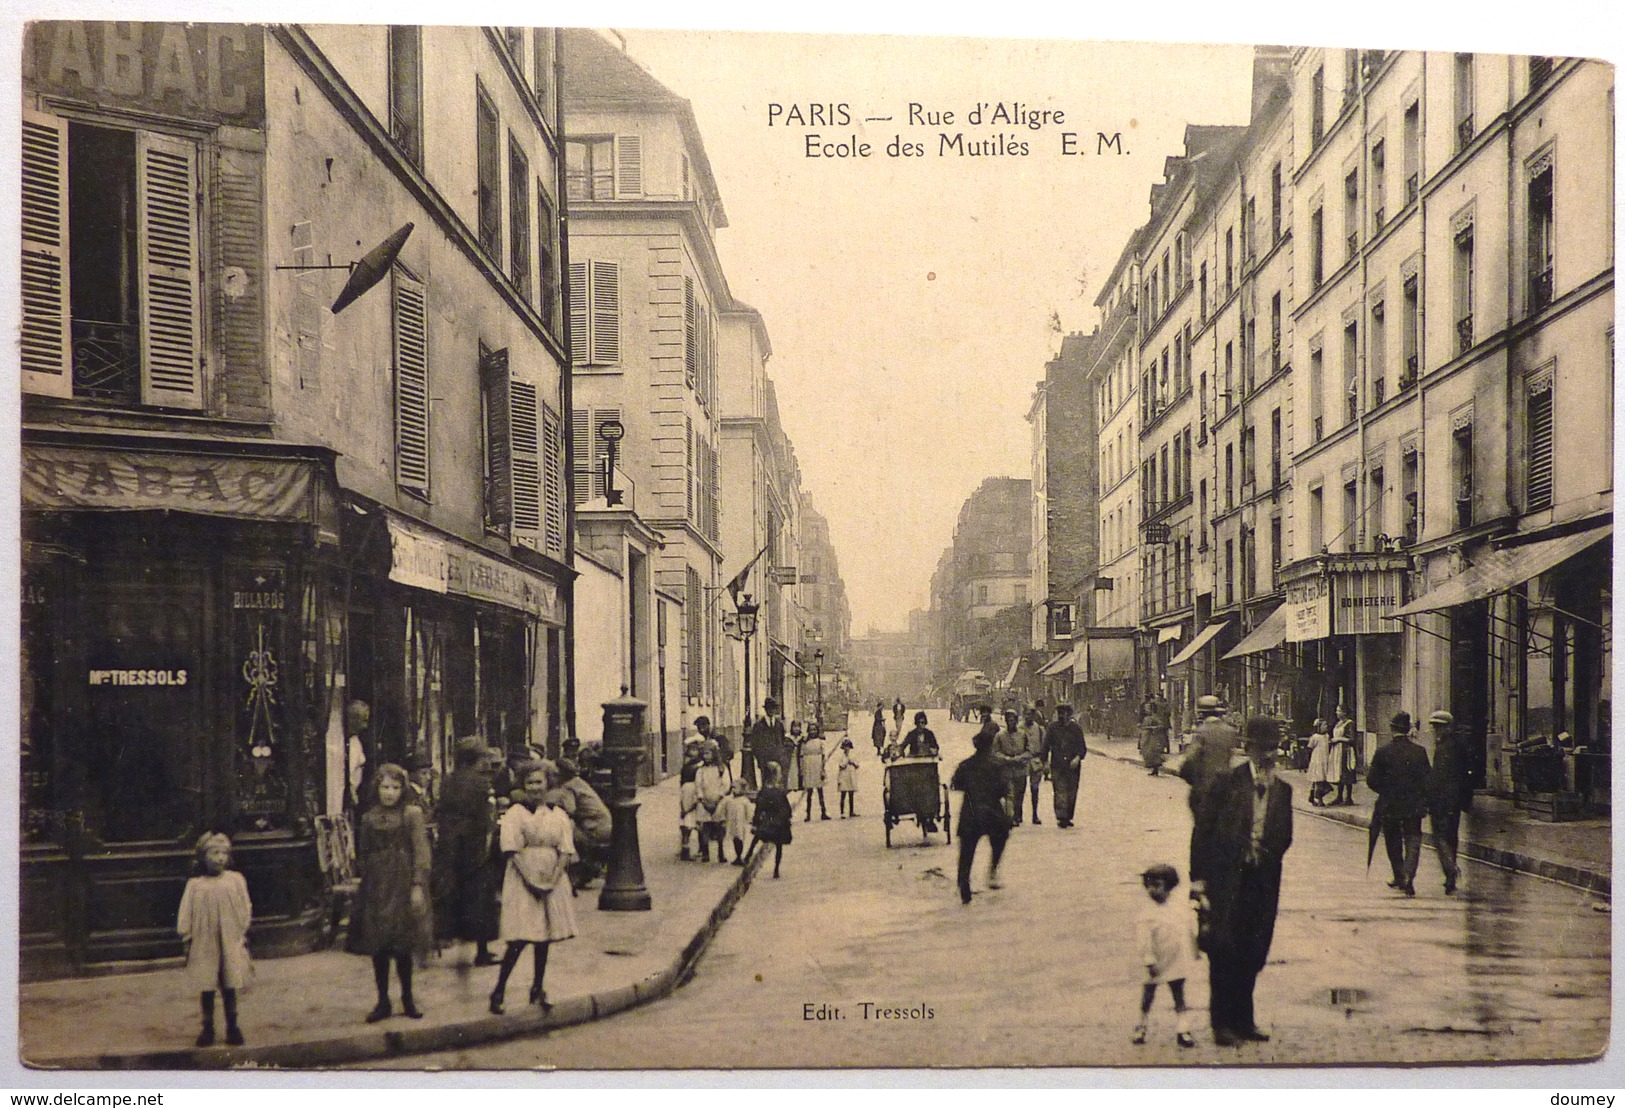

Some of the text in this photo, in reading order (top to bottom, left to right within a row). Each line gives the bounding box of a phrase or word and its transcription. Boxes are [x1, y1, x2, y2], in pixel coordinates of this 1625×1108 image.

[25, 460, 277, 502] TABAC
[233, 590, 285, 610] BILLARDS
[1340, 596, 1396, 608] BONNETERIE
